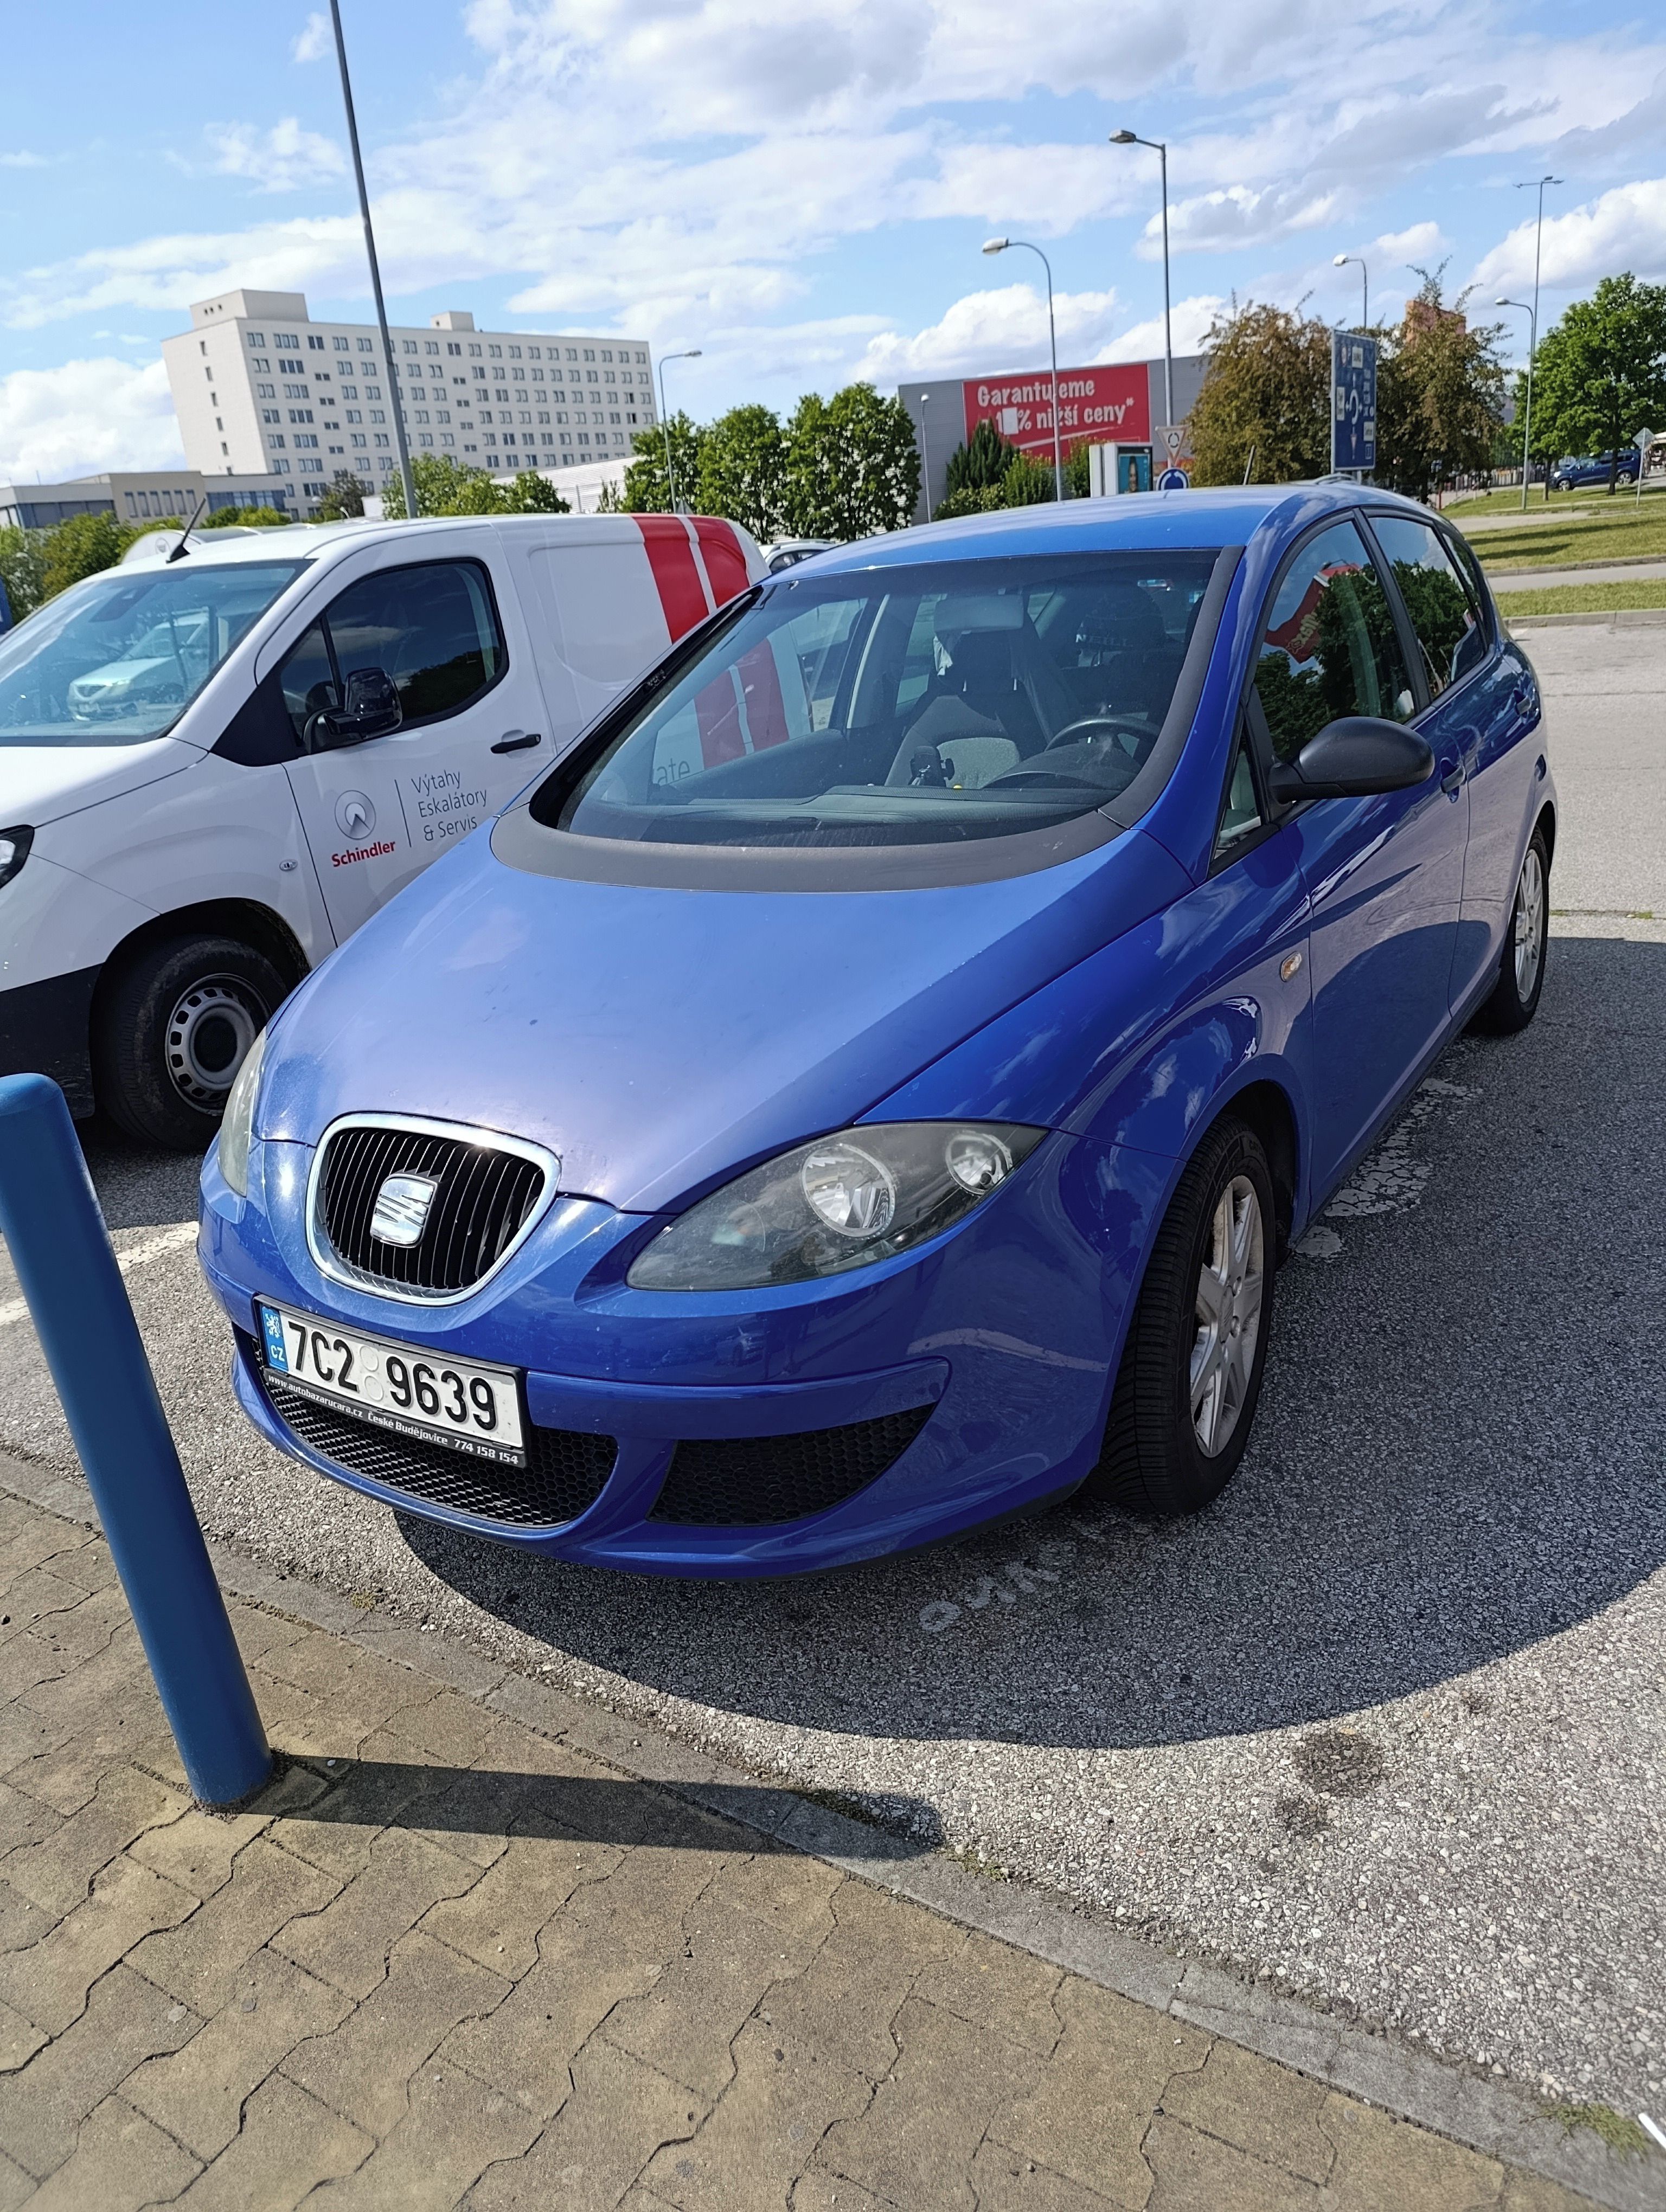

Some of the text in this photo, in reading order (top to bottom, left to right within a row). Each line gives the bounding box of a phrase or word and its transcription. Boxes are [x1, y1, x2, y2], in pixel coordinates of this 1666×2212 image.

[978, 380, 1094, 407] Garantueme
[411, 769, 460, 796] Výtahy
[418, 789, 487, 818] Eskalátory
[424, 814, 477, 841] & Servis
[331, 841, 395, 867] Schindler
[271, 1345, 285, 1361] CZ
[288, 1321, 496, 1430] 7C2 9639
[268, 1375, 518, 1464] www.autobazarucara.cz České Budějovice 774 158 154
